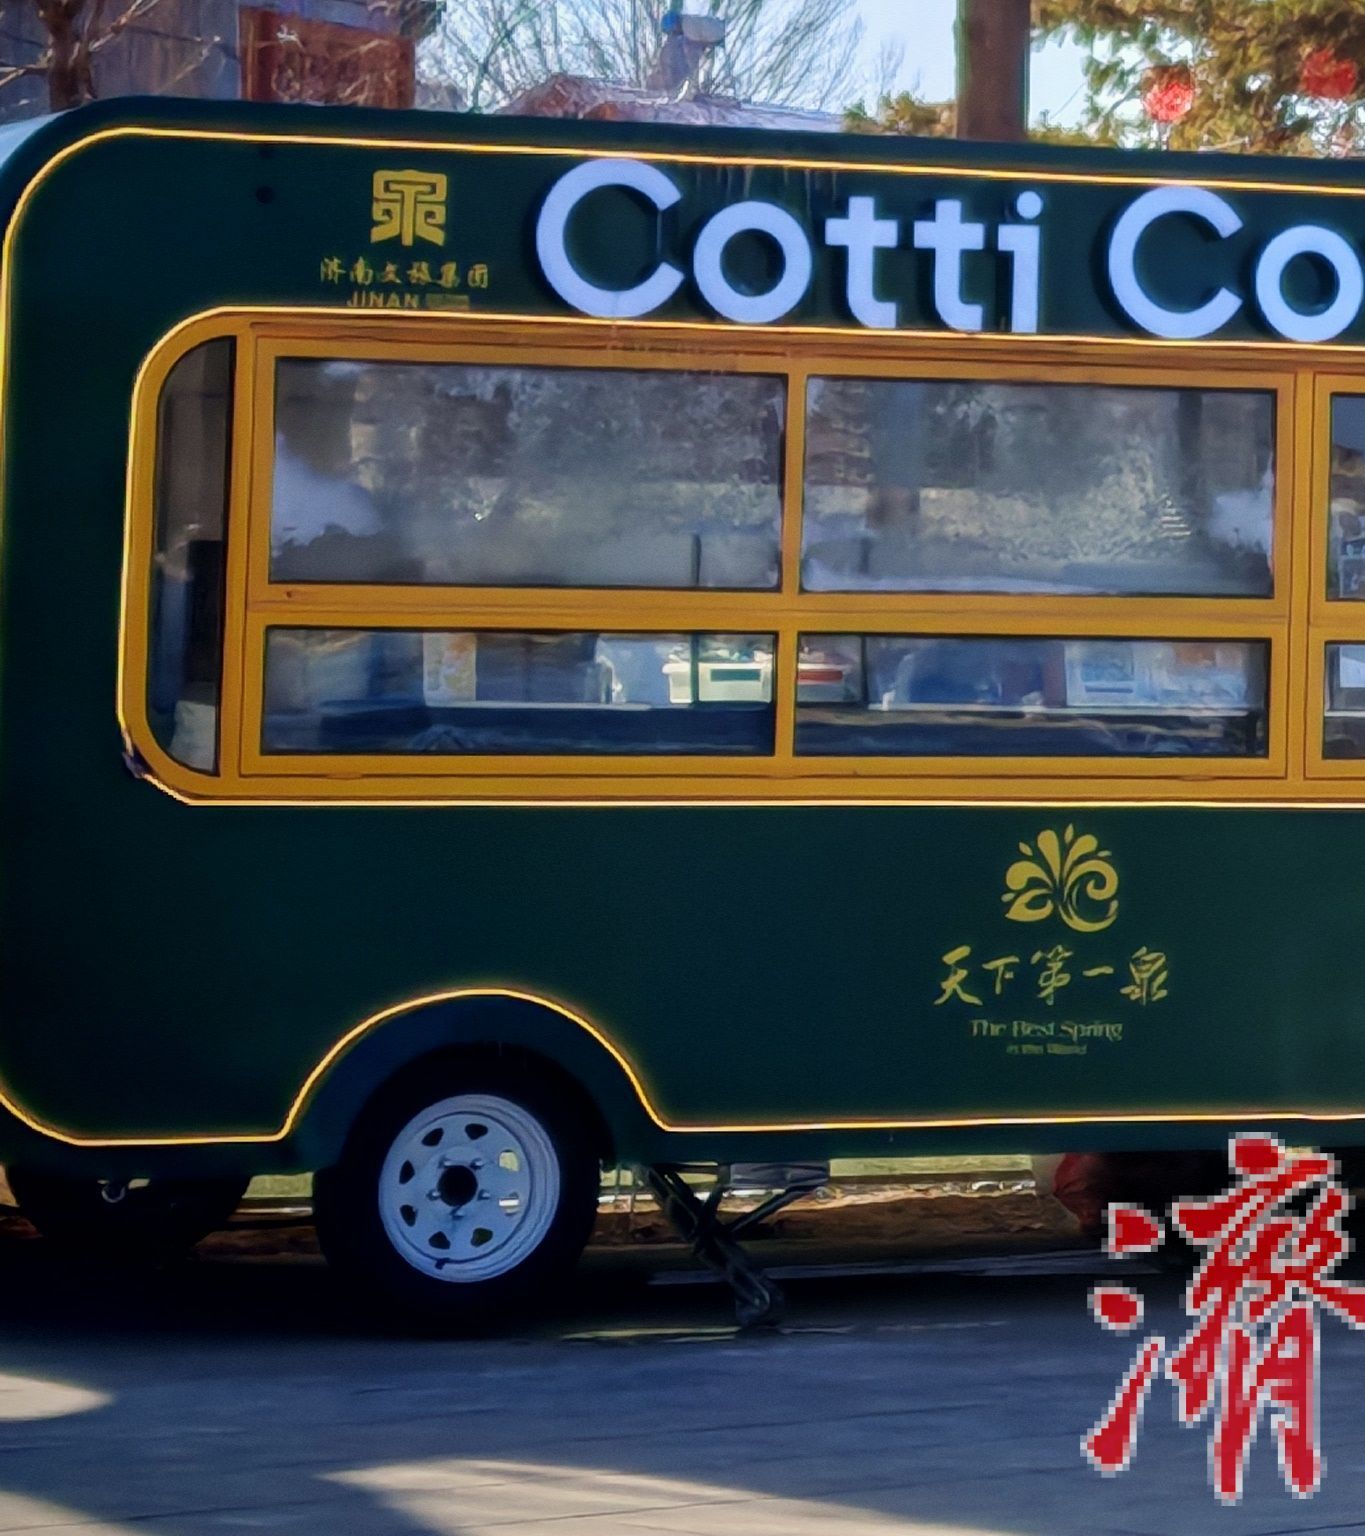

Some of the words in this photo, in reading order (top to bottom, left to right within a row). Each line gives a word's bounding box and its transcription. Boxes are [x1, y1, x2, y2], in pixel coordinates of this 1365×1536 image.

[535, 158, 1043, 334] Cotti
[346, 291, 420, 308] JINAN
[933, 944, 1169, 1006] 天下第一泉
